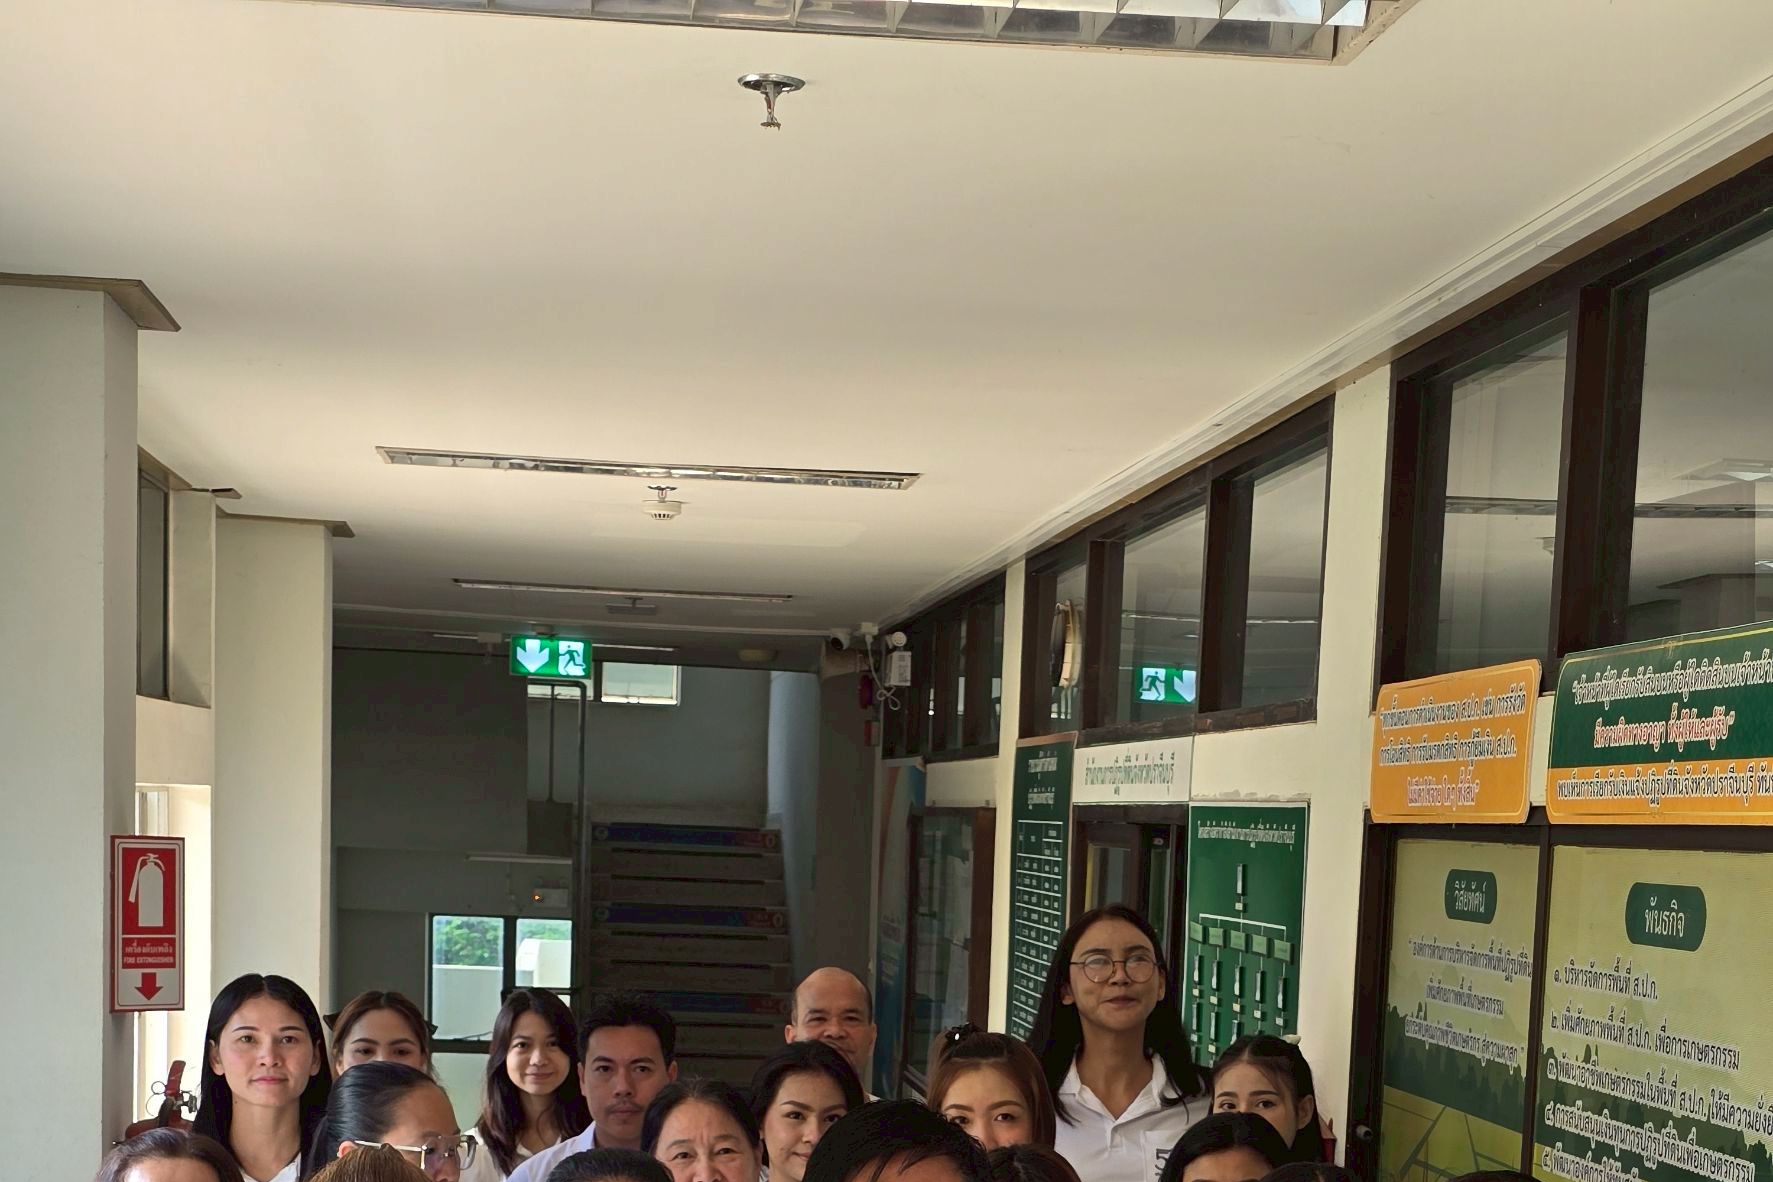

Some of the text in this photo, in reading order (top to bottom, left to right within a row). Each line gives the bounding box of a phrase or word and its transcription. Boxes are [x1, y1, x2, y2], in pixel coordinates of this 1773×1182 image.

[1454, 880, 1487, 913] วิสัยทัศน์
[1645, 895, 1685, 938] พันธกิจ
[1564, 957, 1631, 996] บริหารจัดการพื้นที่
[1633, 973, 1658, 1000] ส.ป.ก.
[1627, 1022, 1652, 1050] ส.ป.ก.
[1655, 1018, 1740, 1071] เพื่อการเกษตรกรรม
[1680, 1088, 1706, 1118] ส.ป.ก.
